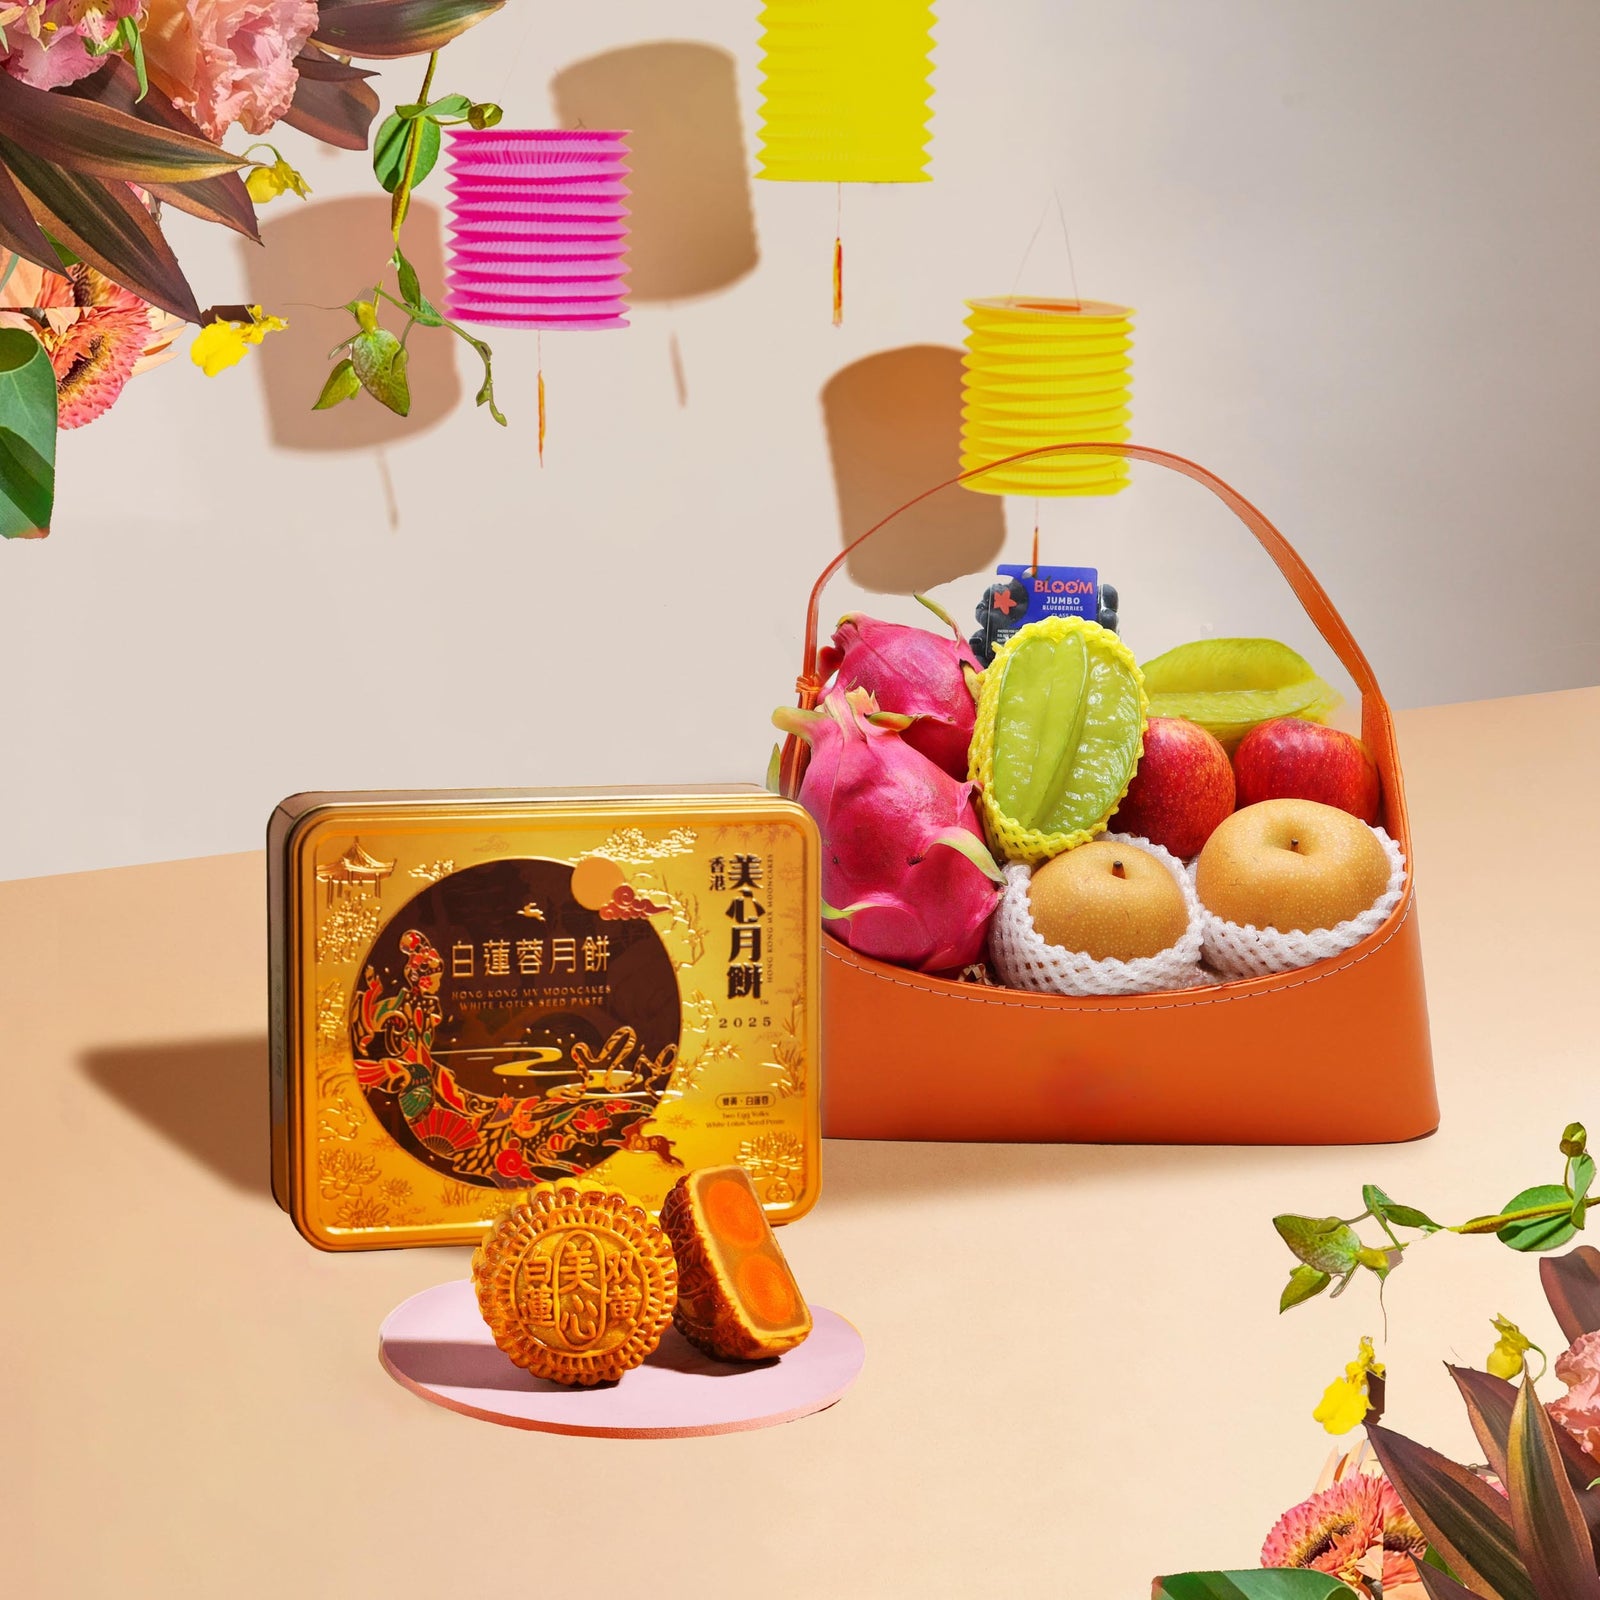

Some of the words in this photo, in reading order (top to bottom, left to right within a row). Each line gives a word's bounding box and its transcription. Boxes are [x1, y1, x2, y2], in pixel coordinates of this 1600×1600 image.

[1034, 579, 1093, 594] BLOOM
[1046, 596, 1080, 605] JUMBO
[709, 855, 726, 891] 香港
[725, 852, 766, 999] 美心月餅
[452, 935, 611, 978] 白蓮蓉月餅
[452, 990, 483, 999] HONG
[488, 988, 518, 998] KONG
[543, 984, 612, 996] MOONCAKES
[459, 1001, 494, 1011] WHITE
[499, 1000, 534, 1009] LOTUS
[538, 998, 566, 1008] SEED
[571, 996, 604, 1006] PASTE
[718, 1016, 772, 1029] 2025
[559, 1241, 601, 1340] 美心
